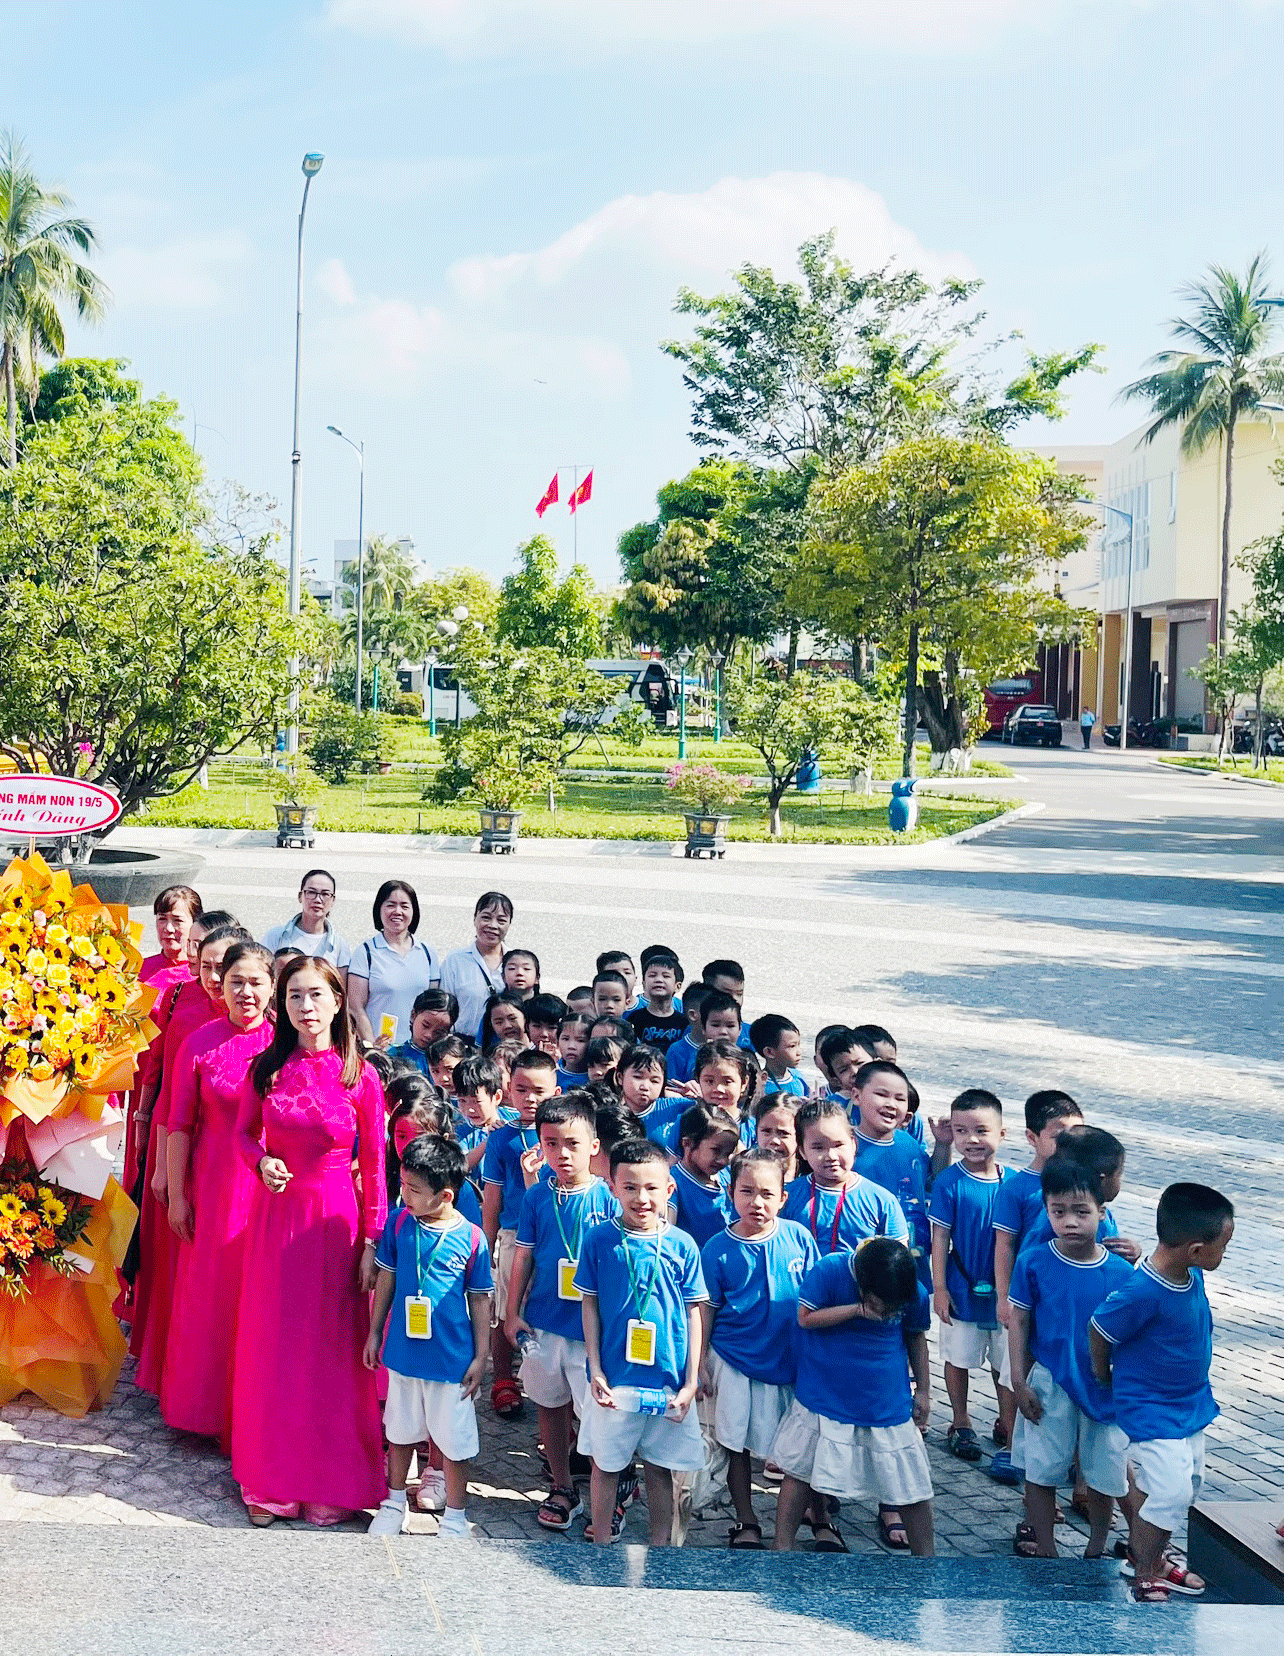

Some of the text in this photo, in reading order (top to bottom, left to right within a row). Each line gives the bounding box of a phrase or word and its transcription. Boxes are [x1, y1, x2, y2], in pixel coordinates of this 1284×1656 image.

[50, 795, 75, 807] NON
[78, 796, 103, 808] 19/5
[32, 809, 87, 827] Dâng
